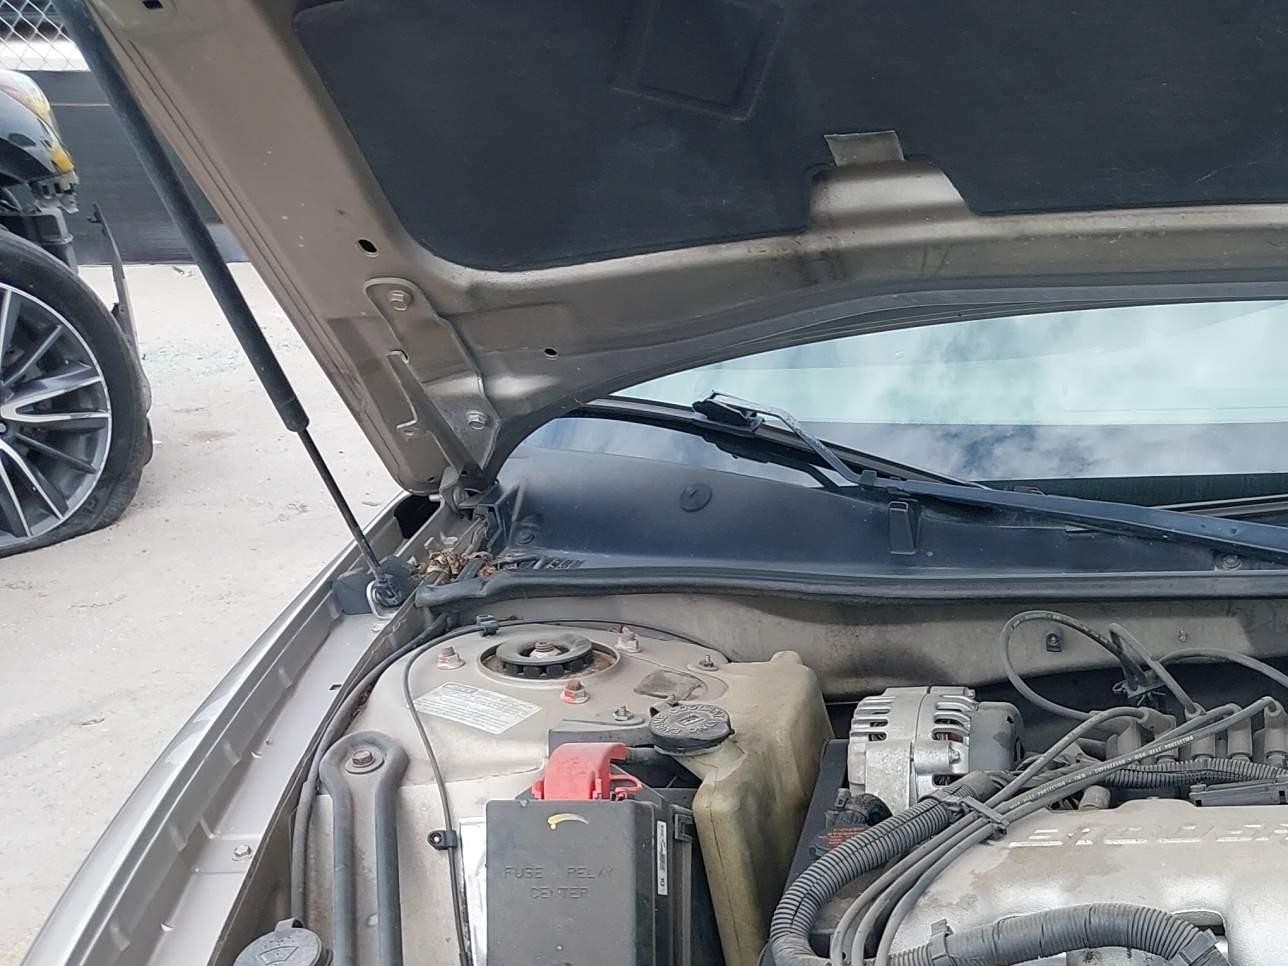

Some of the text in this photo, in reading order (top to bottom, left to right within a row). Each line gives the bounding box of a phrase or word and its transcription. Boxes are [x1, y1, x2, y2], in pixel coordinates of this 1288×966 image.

[504, 865, 614, 879] FUSE RELAY
[530, 887, 590, 899] CENTER
